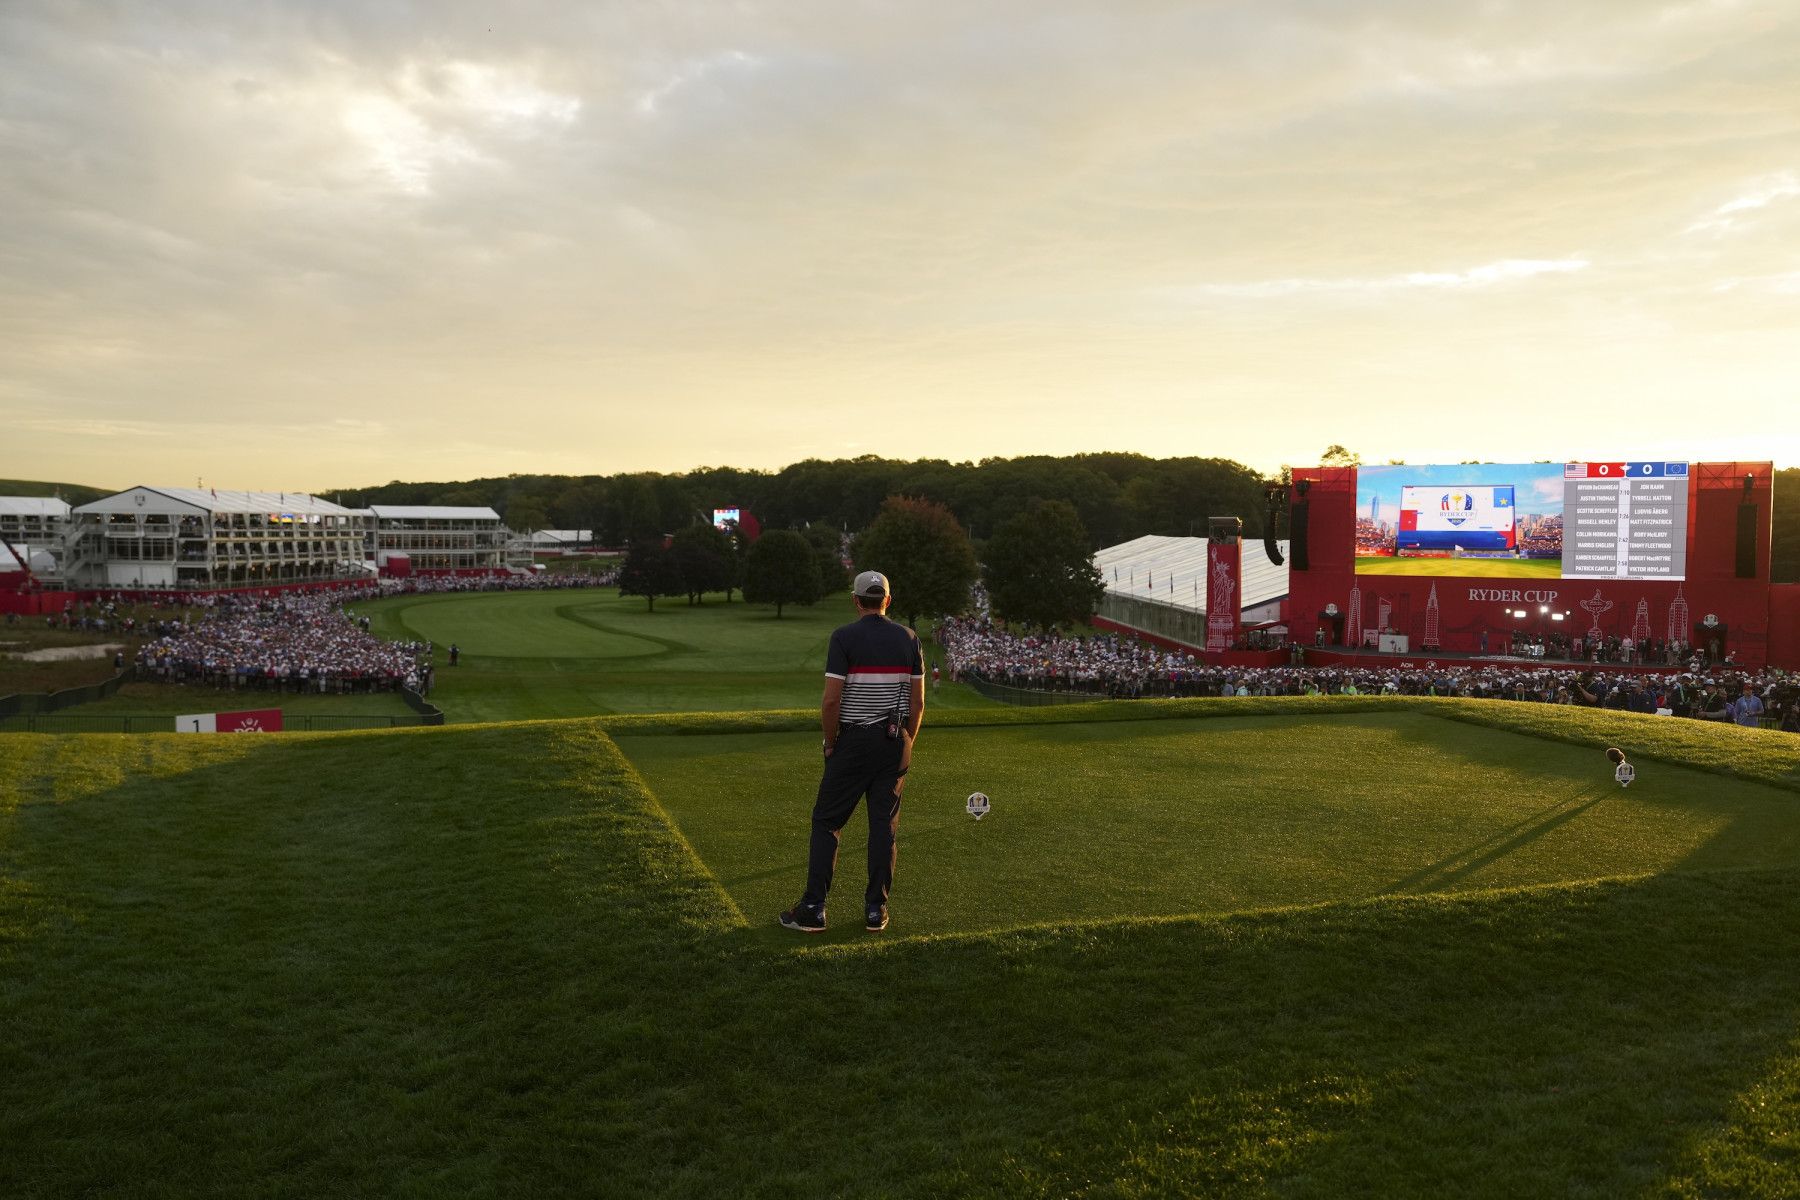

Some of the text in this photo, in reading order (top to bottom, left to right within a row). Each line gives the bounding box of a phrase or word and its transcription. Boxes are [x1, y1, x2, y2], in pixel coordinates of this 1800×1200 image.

[1599, 464, 1608, 475] 0
[1642, 464, 1652, 474] 0
[1468, 588, 1558, 603] RYDER CUP
[192, 720, 199, 733] 1
